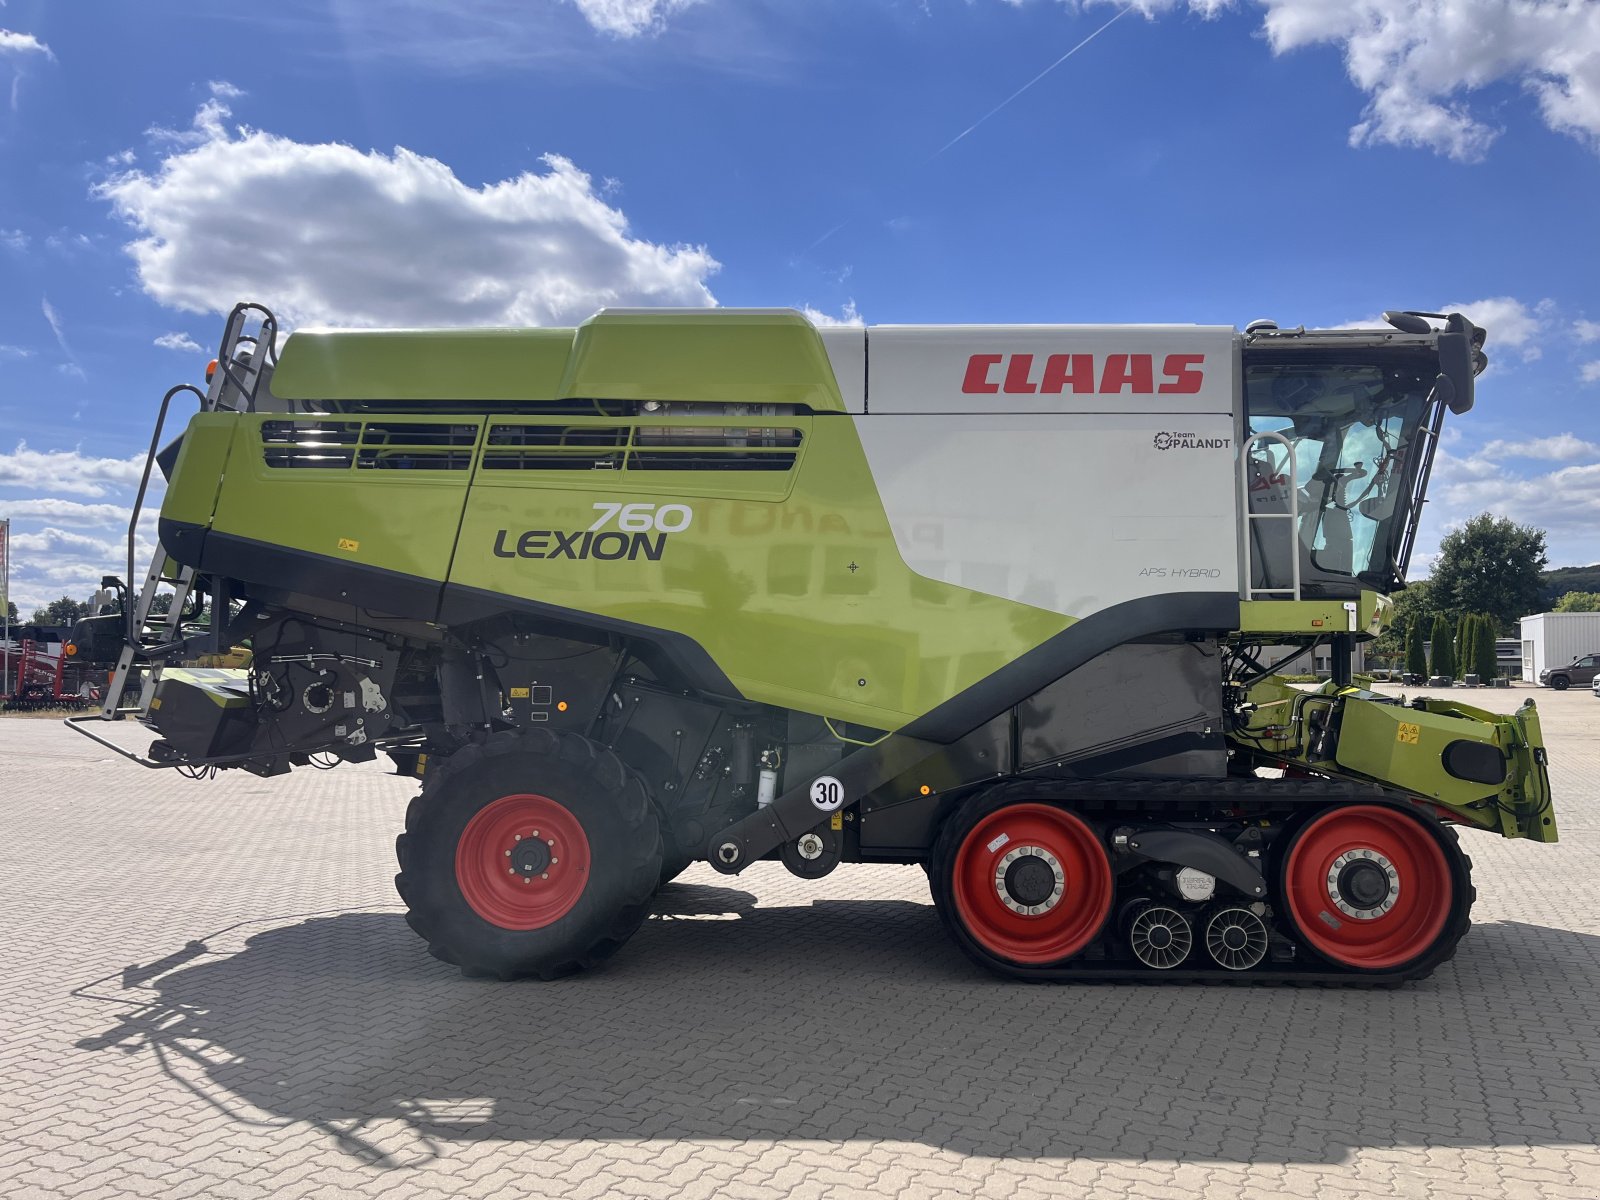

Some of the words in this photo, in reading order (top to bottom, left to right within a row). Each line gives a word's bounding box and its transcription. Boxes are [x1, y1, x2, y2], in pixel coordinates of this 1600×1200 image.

[961, 354, 1205, 394] CLAAS
[1173, 439, 1230, 448] PALANDT
[588, 502, 693, 532] 760
[493, 530, 668, 561] LEXION
[1139, 568, 1167, 577] APS
[1171, 568, 1221, 578] HYBRID
[815, 782, 838, 804] 30
